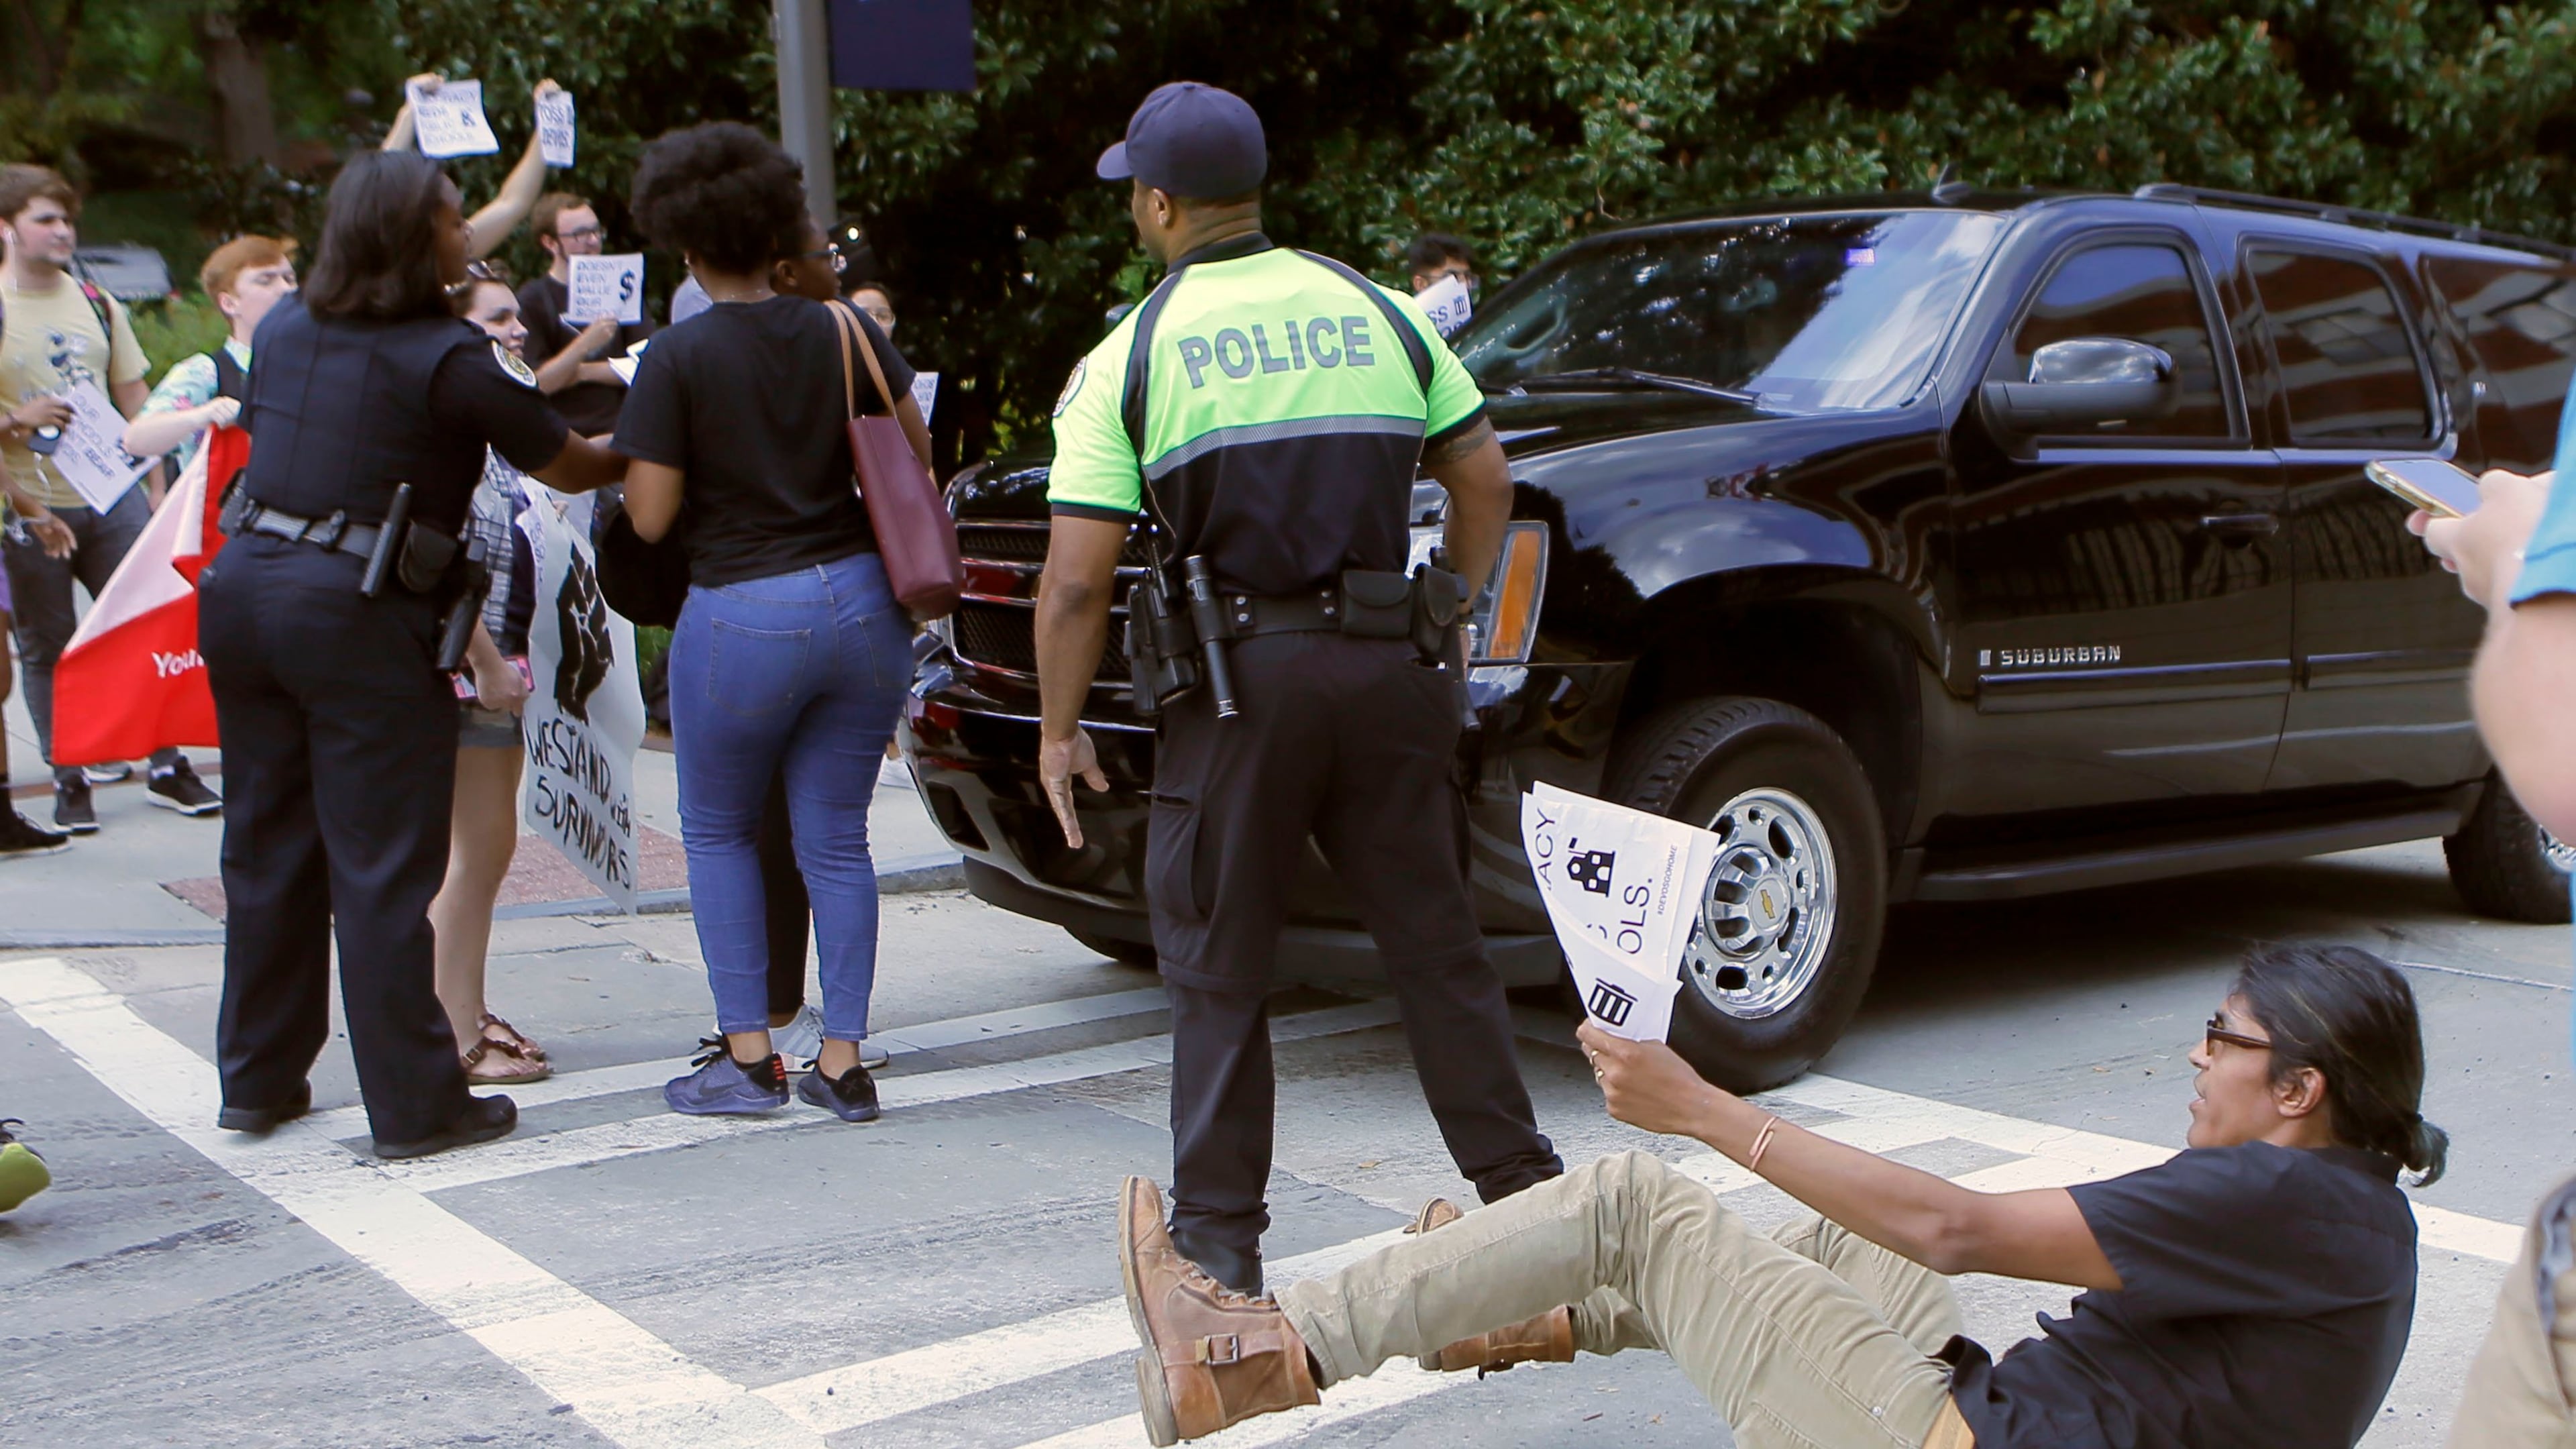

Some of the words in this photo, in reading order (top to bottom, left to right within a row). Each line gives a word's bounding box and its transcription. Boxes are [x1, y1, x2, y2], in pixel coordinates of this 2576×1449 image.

[1177, 316, 1375, 389] POLICE
[2001, 645, 2121, 665] SUBURBAN
[535, 774, 631, 890] SURVIVORS
